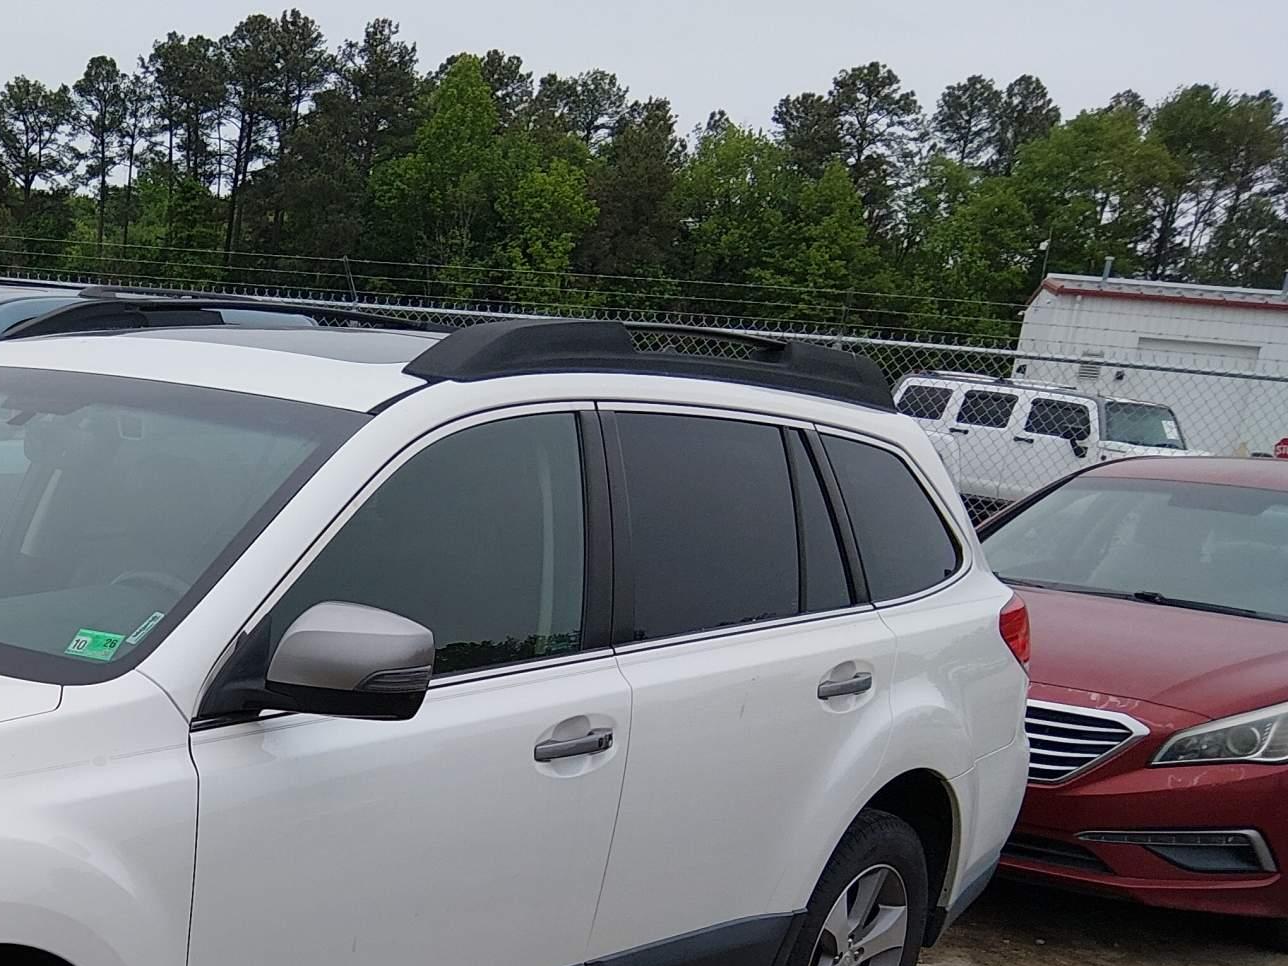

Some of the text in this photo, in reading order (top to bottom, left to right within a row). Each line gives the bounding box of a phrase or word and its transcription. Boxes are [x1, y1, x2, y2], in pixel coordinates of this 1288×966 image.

[1276, 445, 1288, 455] ST
[72, 638, 87, 651] 10
[103, 638, 118, 649] 26
